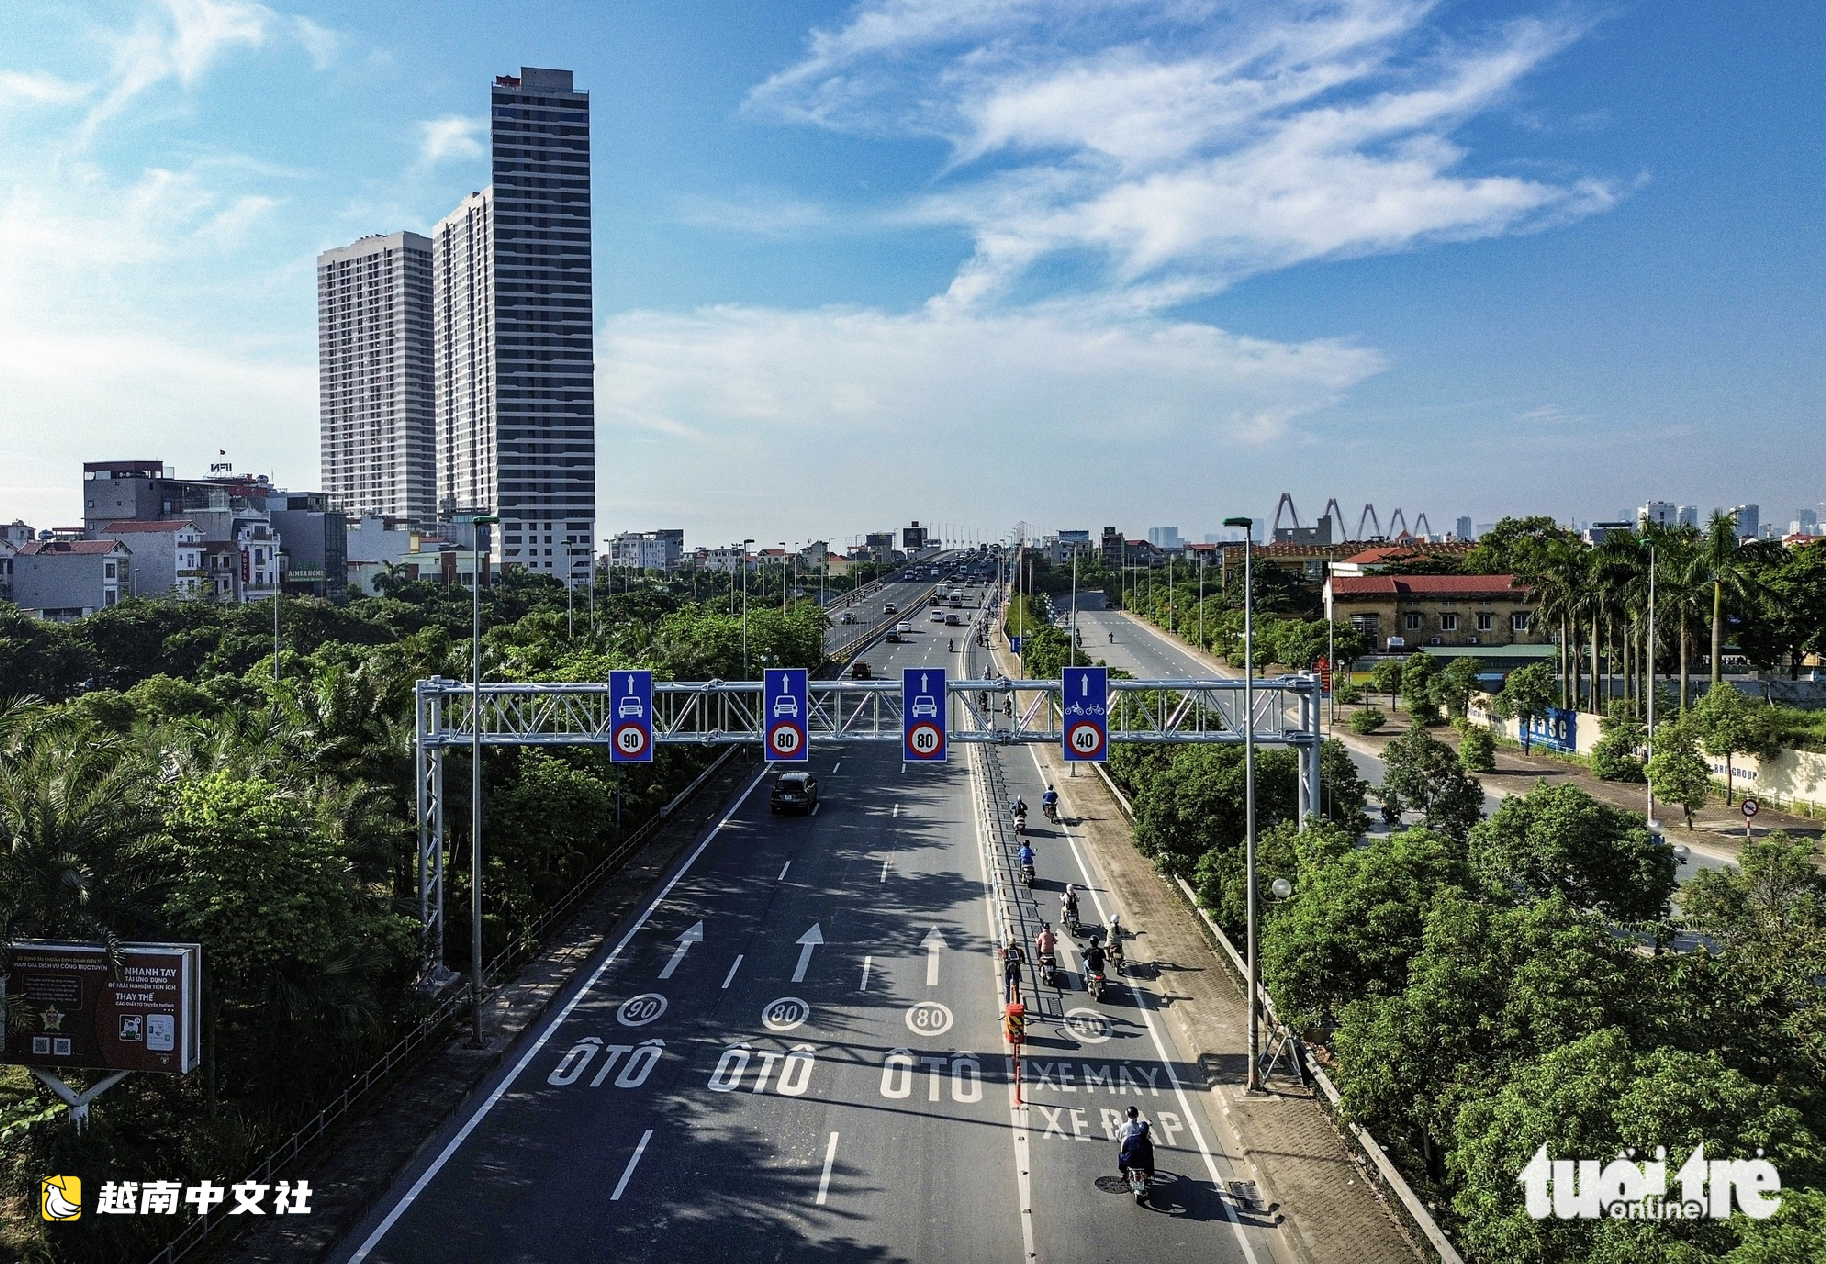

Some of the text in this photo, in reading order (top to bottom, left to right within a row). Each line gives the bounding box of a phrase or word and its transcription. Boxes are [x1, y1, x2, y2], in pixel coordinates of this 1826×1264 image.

[624, 734, 638, 748] 90
[778, 733, 794, 748] 80
[918, 734, 932, 748] 80
[1076, 733, 1093, 748] 40
[124, 967, 177, 977] NHANH TAY
[115, 992, 137, 1000] THAY
[627, 1000, 656, 1018] 90
[772, 1004, 798, 1022] 80
[916, 1010, 942, 1028] 80
[1074, 1017, 1102, 1034] 40
[1031, 1061, 1077, 1092] XE
[1037, 1106, 1184, 1146] XE ĐP
